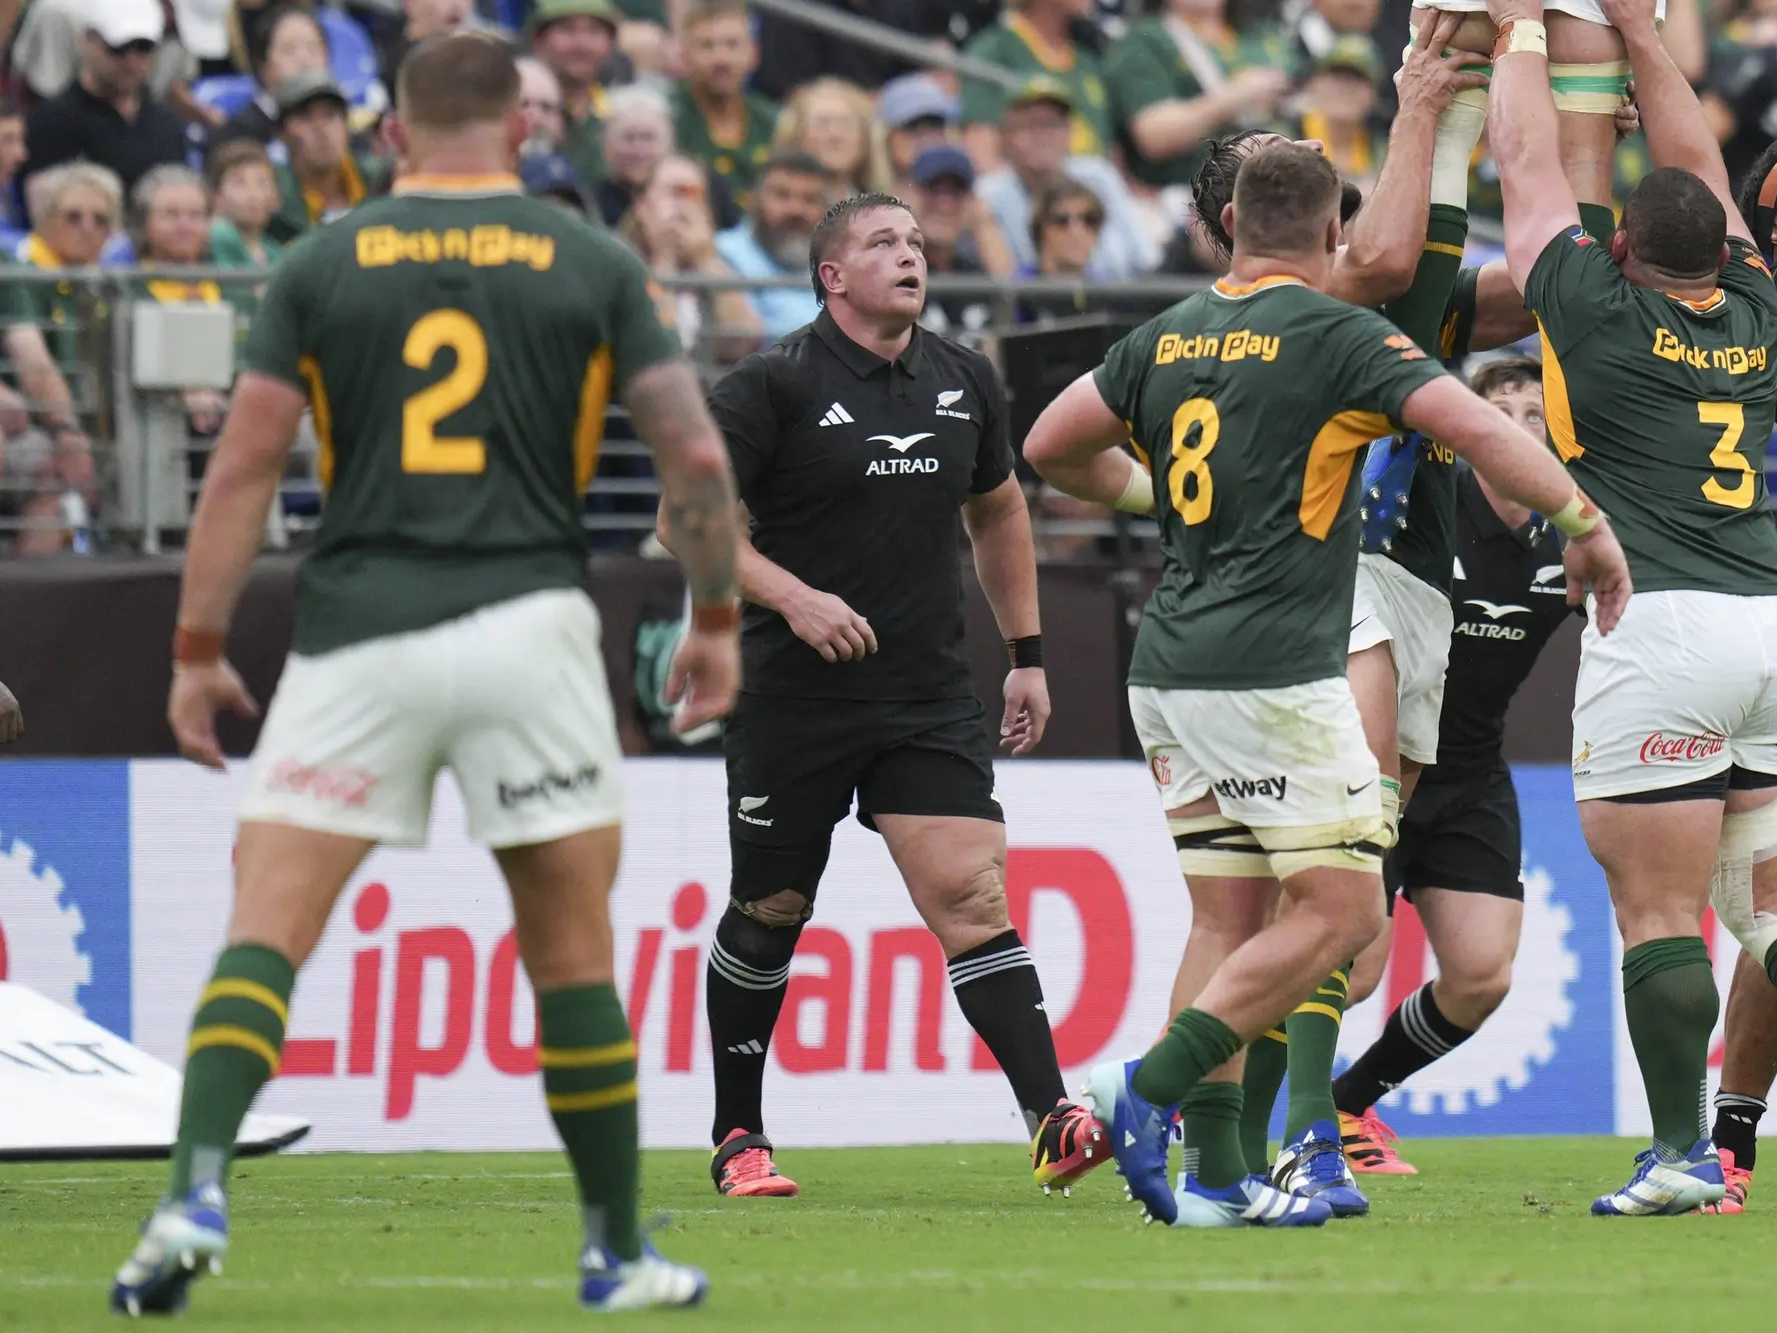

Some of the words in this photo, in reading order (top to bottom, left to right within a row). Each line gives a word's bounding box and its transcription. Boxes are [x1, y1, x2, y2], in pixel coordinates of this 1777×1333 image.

[1220, 329, 1280, 362] Pay
[1725, 346, 1767, 375] Pay
[402, 307, 487, 474] 2
[865, 458, 939, 476] ALTRAD
[1168, 397, 1220, 526] 8
[1698, 401, 1756, 509] 3
[1454, 622, 1525, 641] ALTRAD
[1214, 775, 1286, 801] etway
